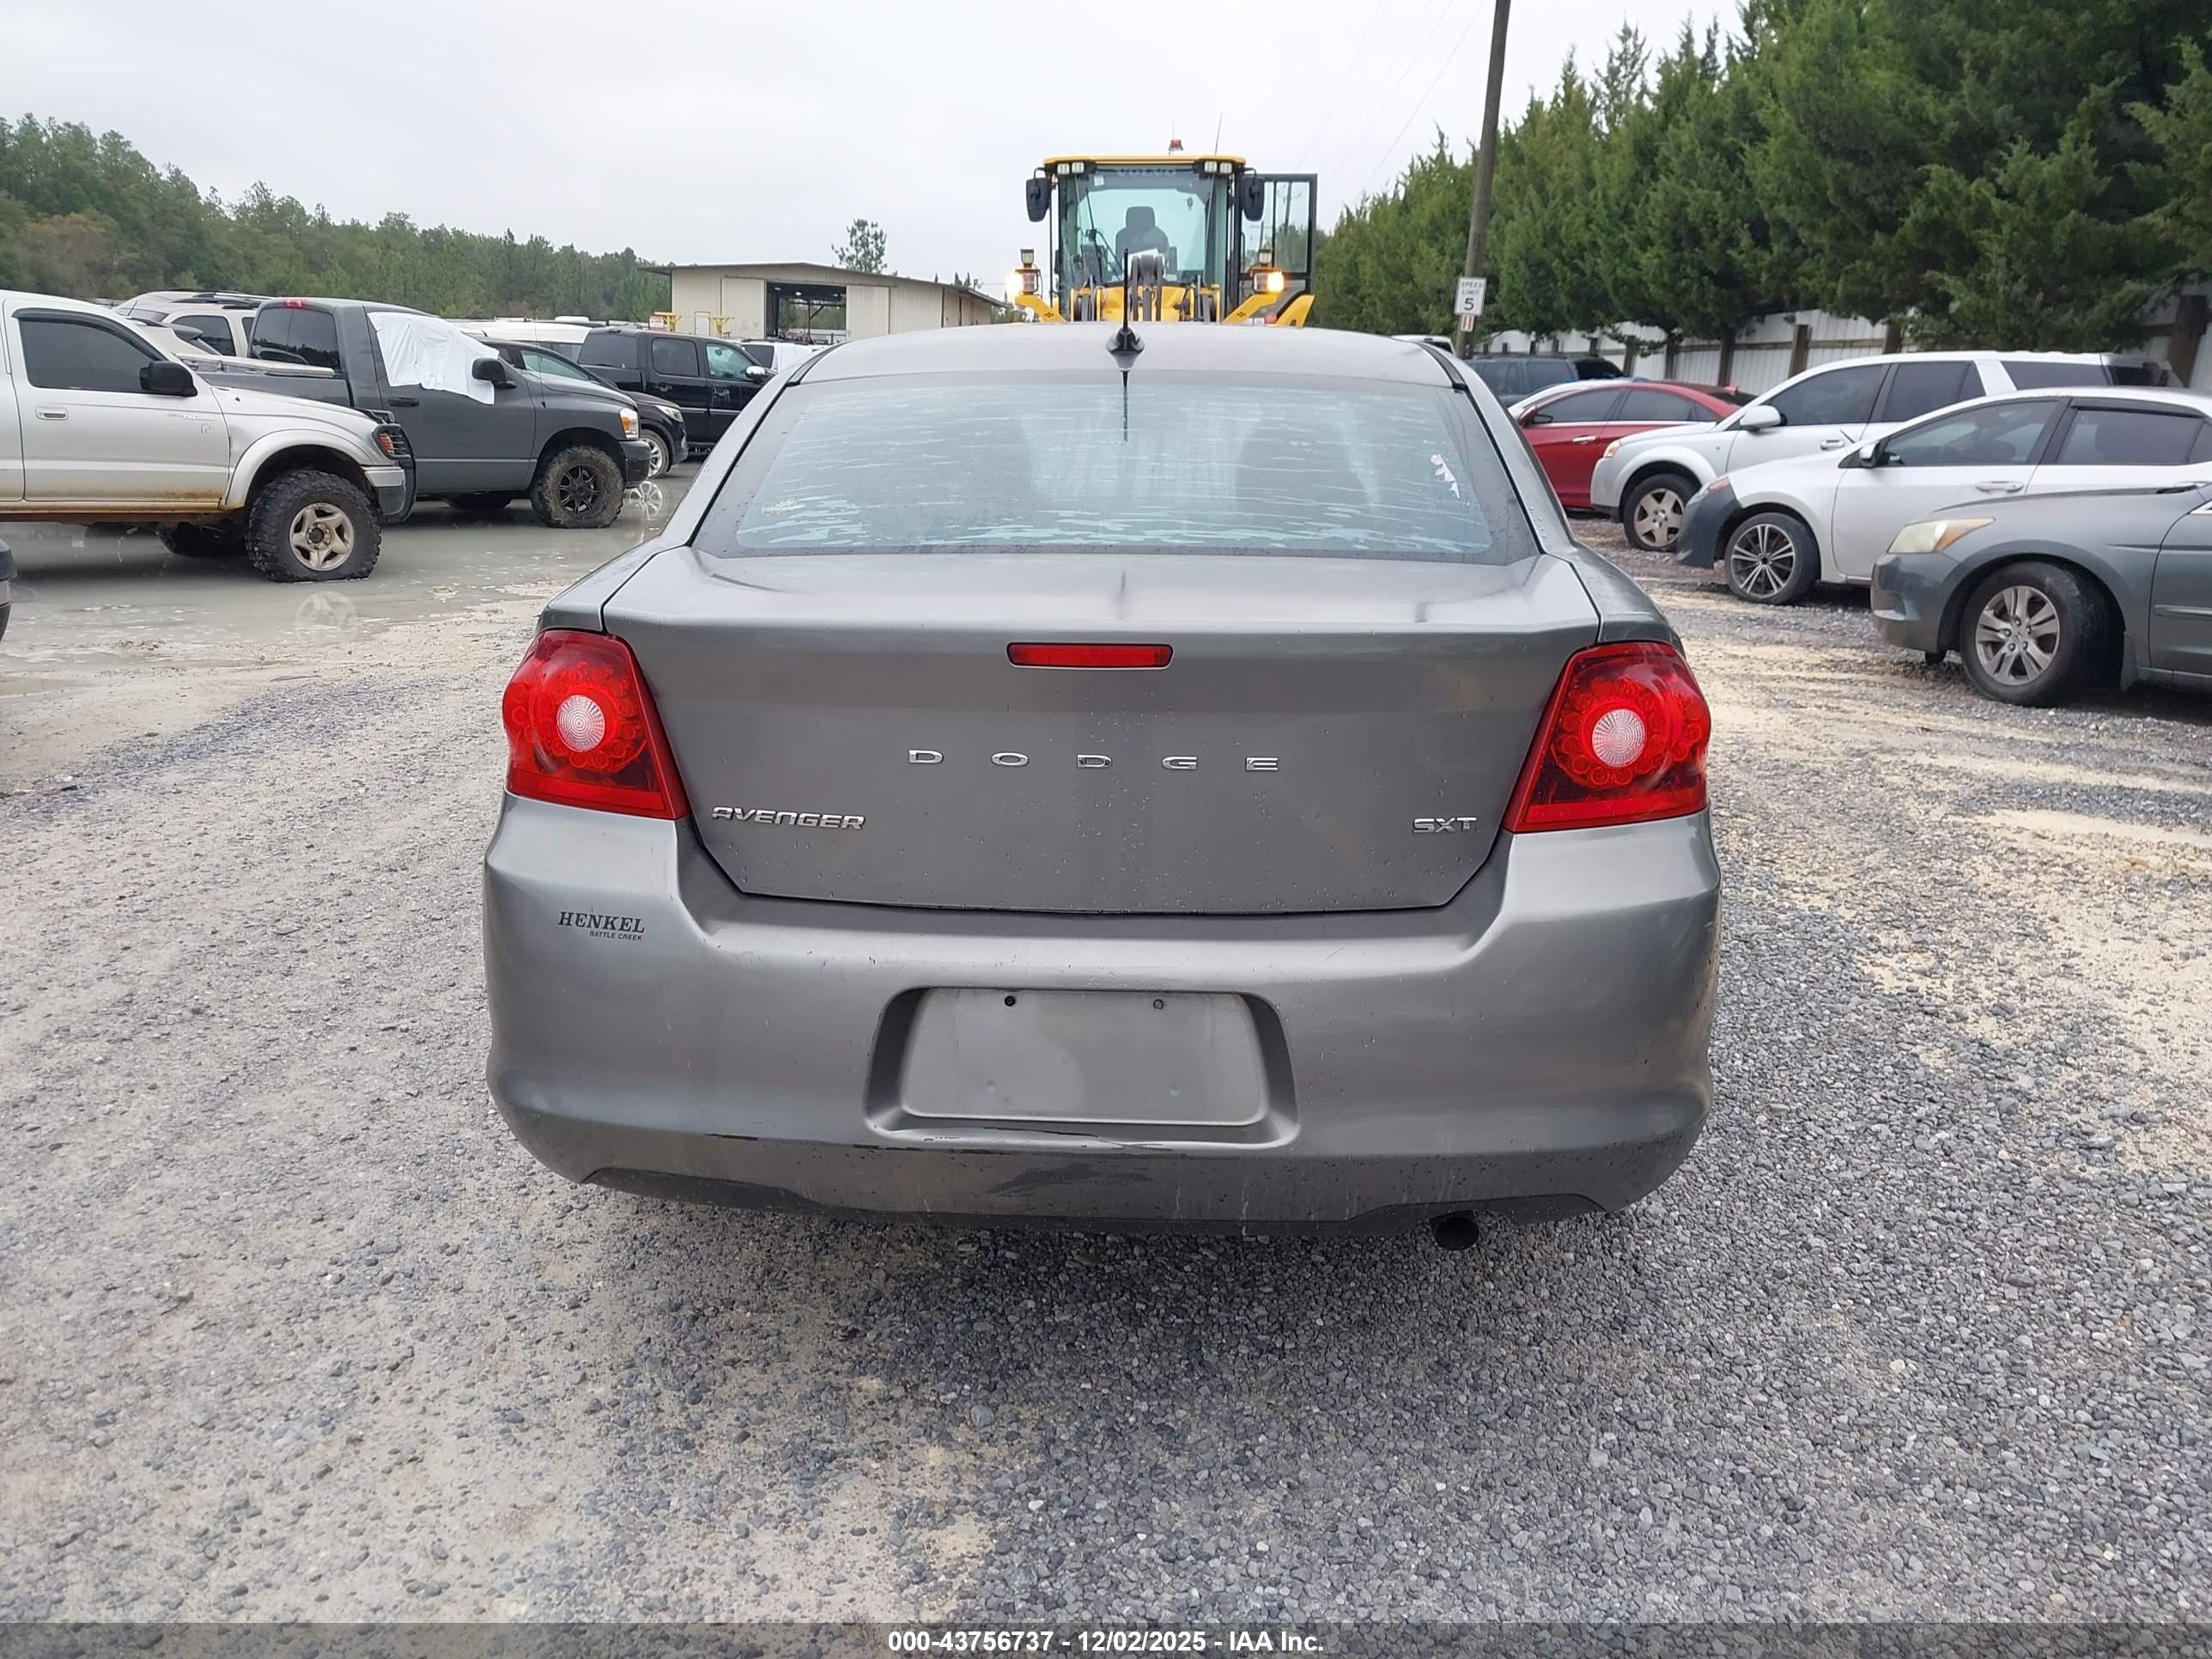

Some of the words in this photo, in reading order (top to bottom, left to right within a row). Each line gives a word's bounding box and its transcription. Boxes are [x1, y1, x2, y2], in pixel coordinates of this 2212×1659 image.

[1464, 297, 1474, 311] 5
[908, 749, 1279, 771] DODGE
[711, 805, 865, 830] AVENGER
[1413, 817, 1478, 833] SXT
[557, 911, 645, 933] HENKEL
[589, 931, 616, 939] BATTLE
[617, 933, 643, 941] CREEK
